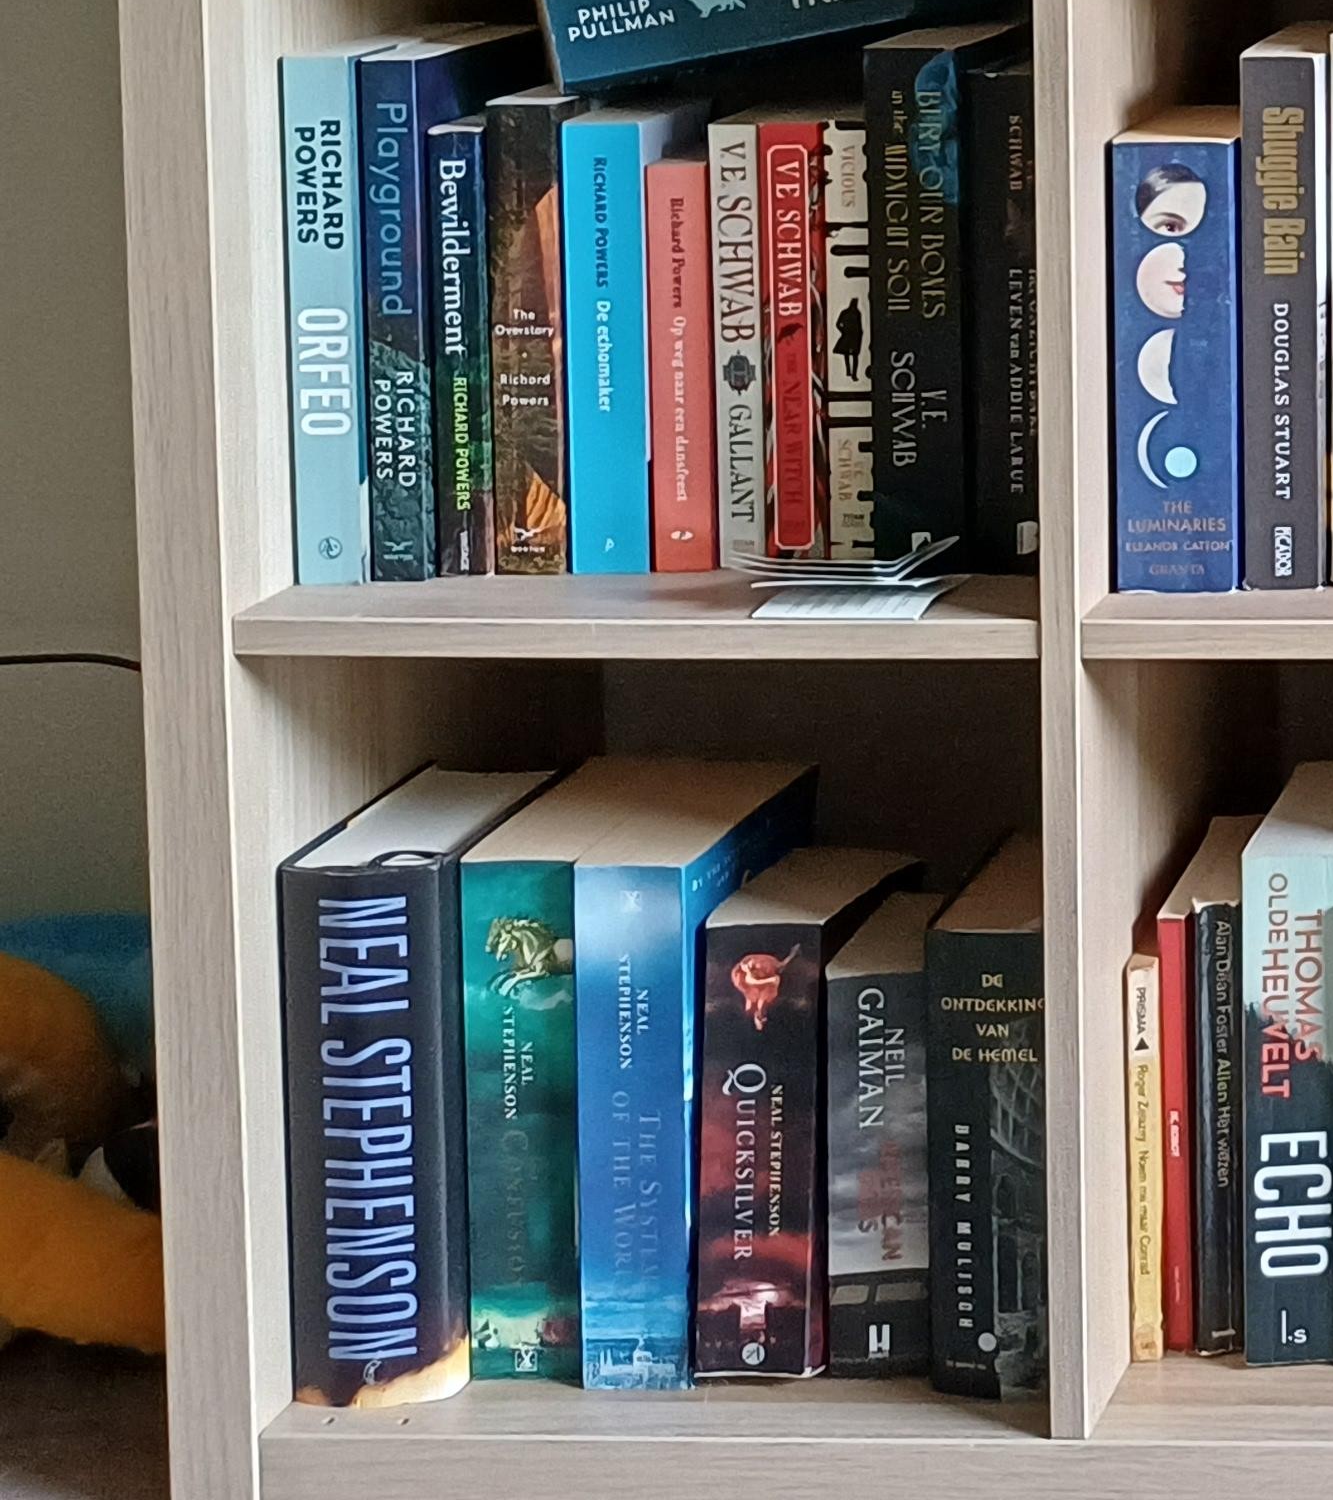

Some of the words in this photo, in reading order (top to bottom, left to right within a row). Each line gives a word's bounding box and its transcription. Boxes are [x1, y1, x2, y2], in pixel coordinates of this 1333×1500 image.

[294, 127, 319, 244] POWERS
[319, 119, 344, 250] RICHARD
[367, 101, 413, 316] Playground
[1262, 107, 1305, 211] Shuggie
[438, 159, 471, 355] Bewilderment
[1263, 218, 1306, 276] Bain
[297, 307, 353, 435] ORFEO
[318, 896, 409, 1026] NEAL
[320, 1037, 417, 1360] STEPHENSON
[722, 1063, 767, 1261] QUICKSILVER
[1253, 1131, 1333, 1279] ECHO
